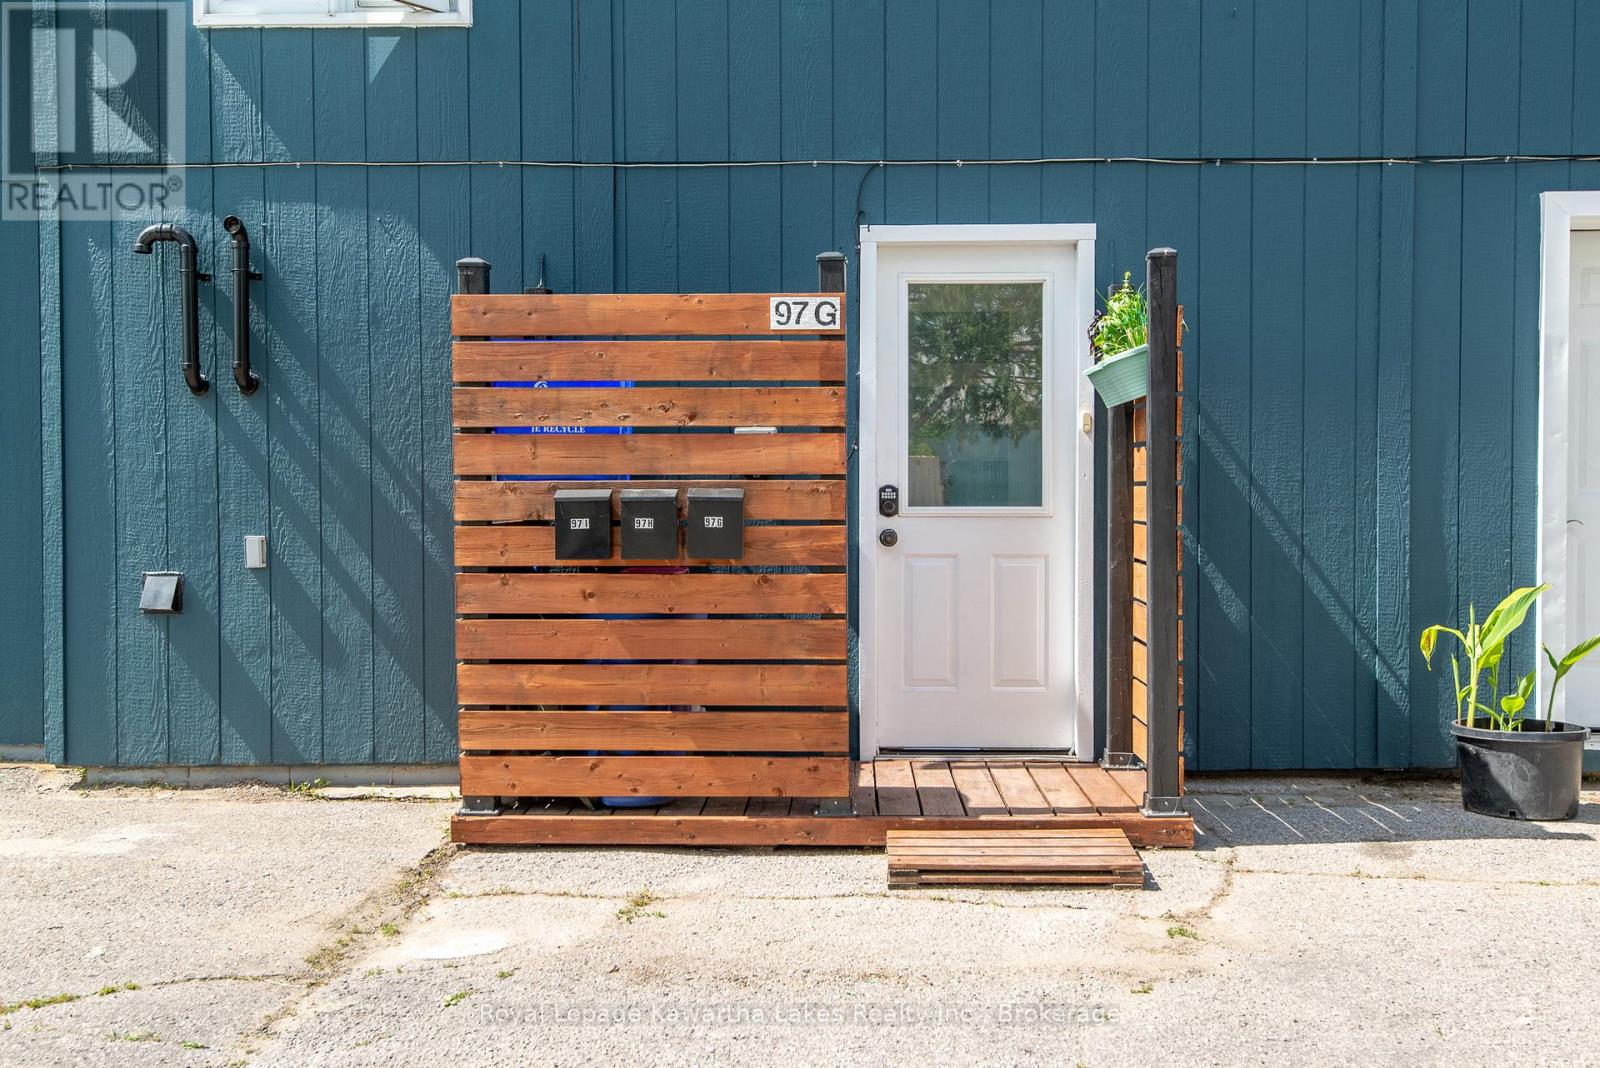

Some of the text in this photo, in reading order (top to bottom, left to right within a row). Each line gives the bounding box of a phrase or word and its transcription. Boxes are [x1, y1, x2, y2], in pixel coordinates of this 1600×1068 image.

[543, 426, 586, 434] RECYCLE
[635, 518, 653, 528] 97H
[705, 517, 722, 527] 97G
